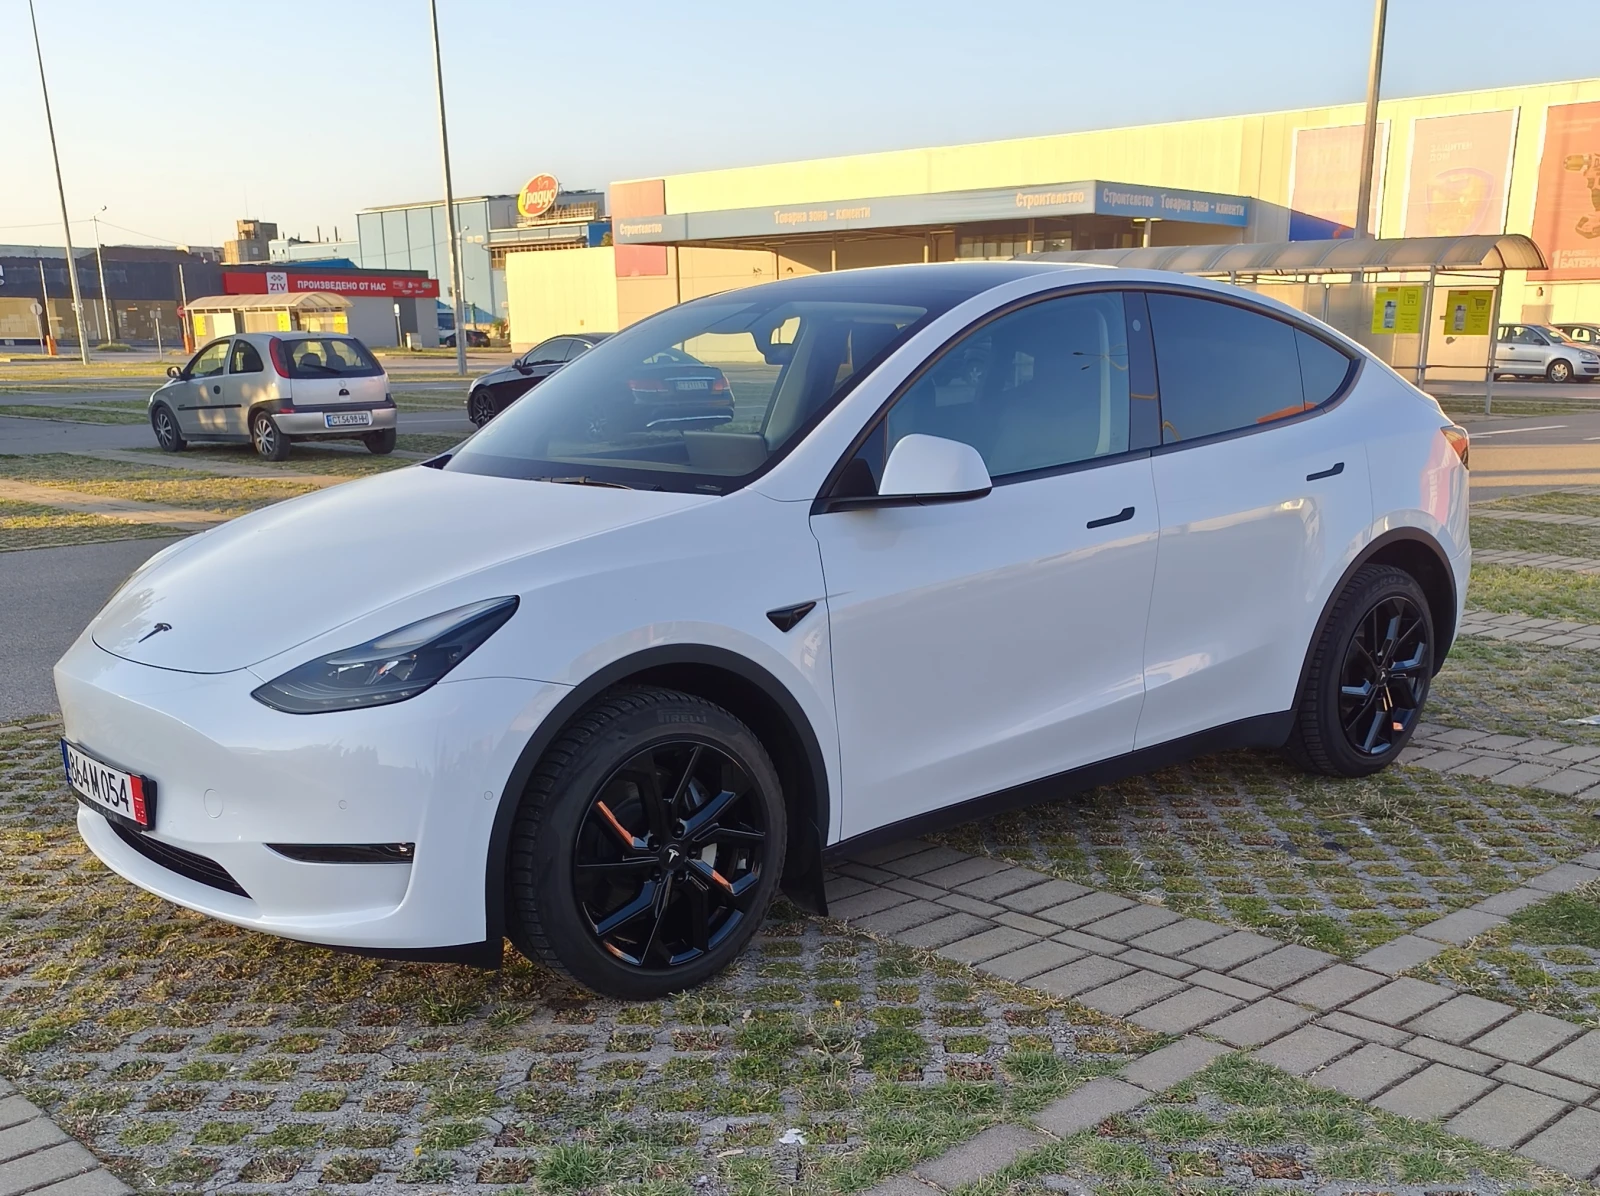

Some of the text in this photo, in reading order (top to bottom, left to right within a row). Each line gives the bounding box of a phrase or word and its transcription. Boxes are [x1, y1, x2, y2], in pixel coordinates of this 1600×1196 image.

[522, 188, 556, 210] Градус
[1016, 191, 1085, 210] Строителство
[1103, 188, 1154, 208] Строителство
[774, 210, 807, 226] Товарна
[808, 209, 828, 222] зона
[269, 283, 287, 292] ZIV
[297, 280, 358, 291] ПРОИЗВЕДЕНО
[359, 281, 369, 291] ОТ
[370, 282, 387, 291] НАС
[656, 708, 707, 723] PIRELLI
